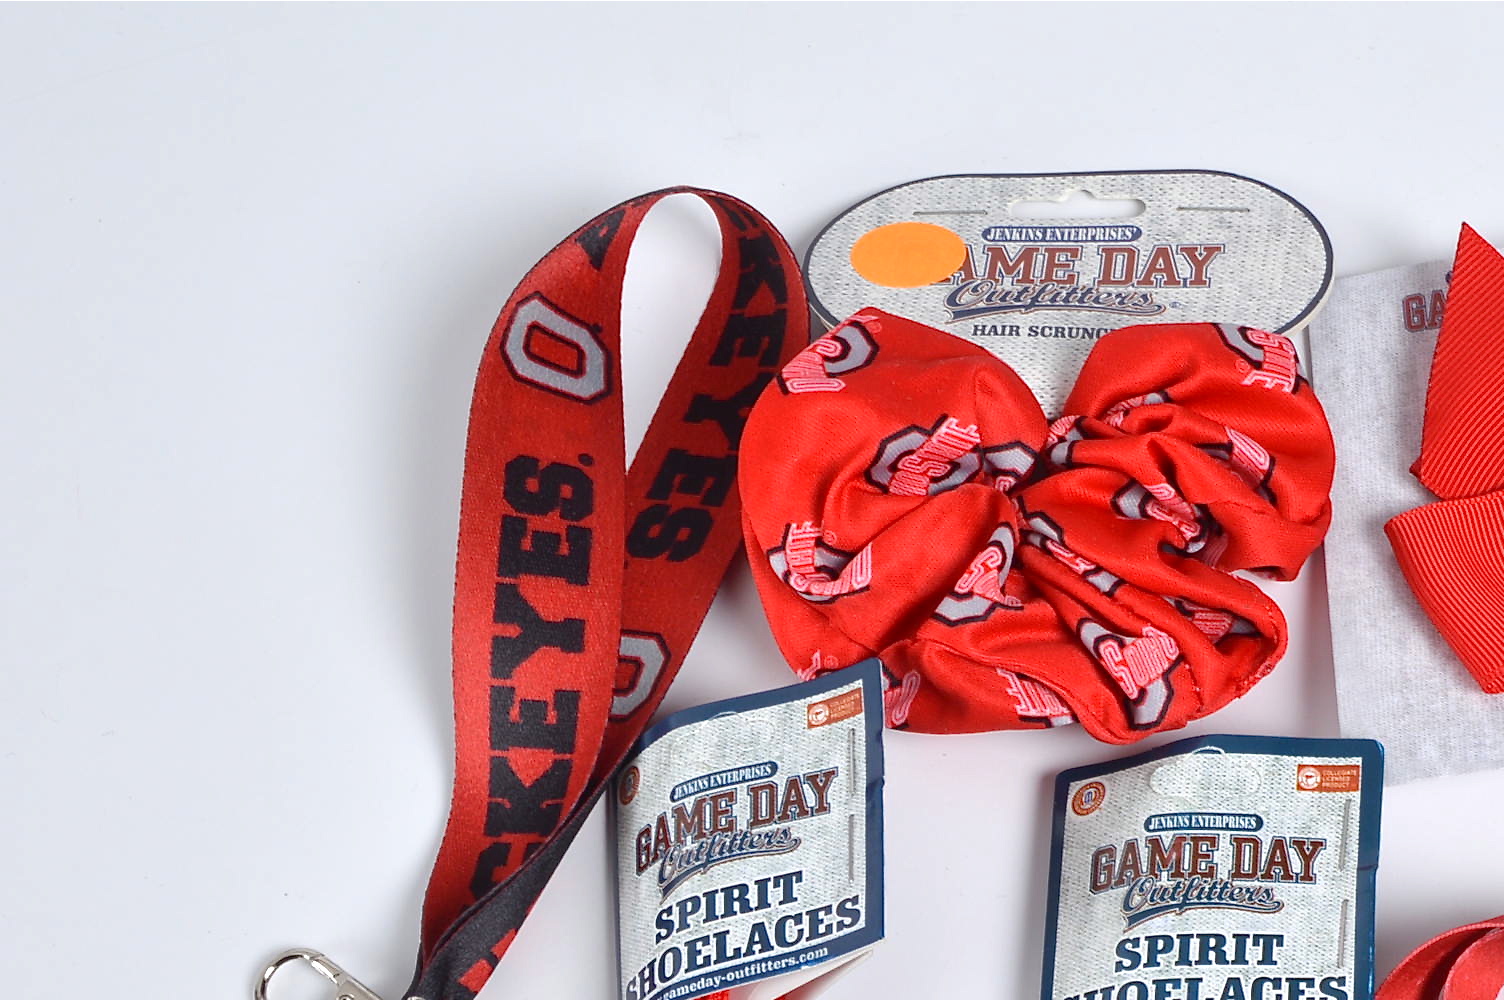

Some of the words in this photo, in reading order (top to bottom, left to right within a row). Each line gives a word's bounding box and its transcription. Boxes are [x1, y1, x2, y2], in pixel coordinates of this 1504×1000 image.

[986, 227, 1042, 241] JENKINS
[937, 243, 1083, 287] AME
[1094, 243, 1225, 288] DAY
[945, 279, 1163, 319] Outfitters
[972, 324, 1021, 337] HAIR
[674, 777, 709, 800] JENKINS
[635, 783, 738, 877] GAME
[748, 766, 838, 833] DAY
[1149, 815, 1190, 830] JENKINS
[659, 825, 798, 895] Outfitters
[1089, 834, 1220, 896] GAME
[1229, 834, 1326, 885] DAY
[654, 870, 803, 945] SPIRIT
[1122, 877, 1280, 927] Outfitters
[1114, 933, 1284, 973] SPIRIT
